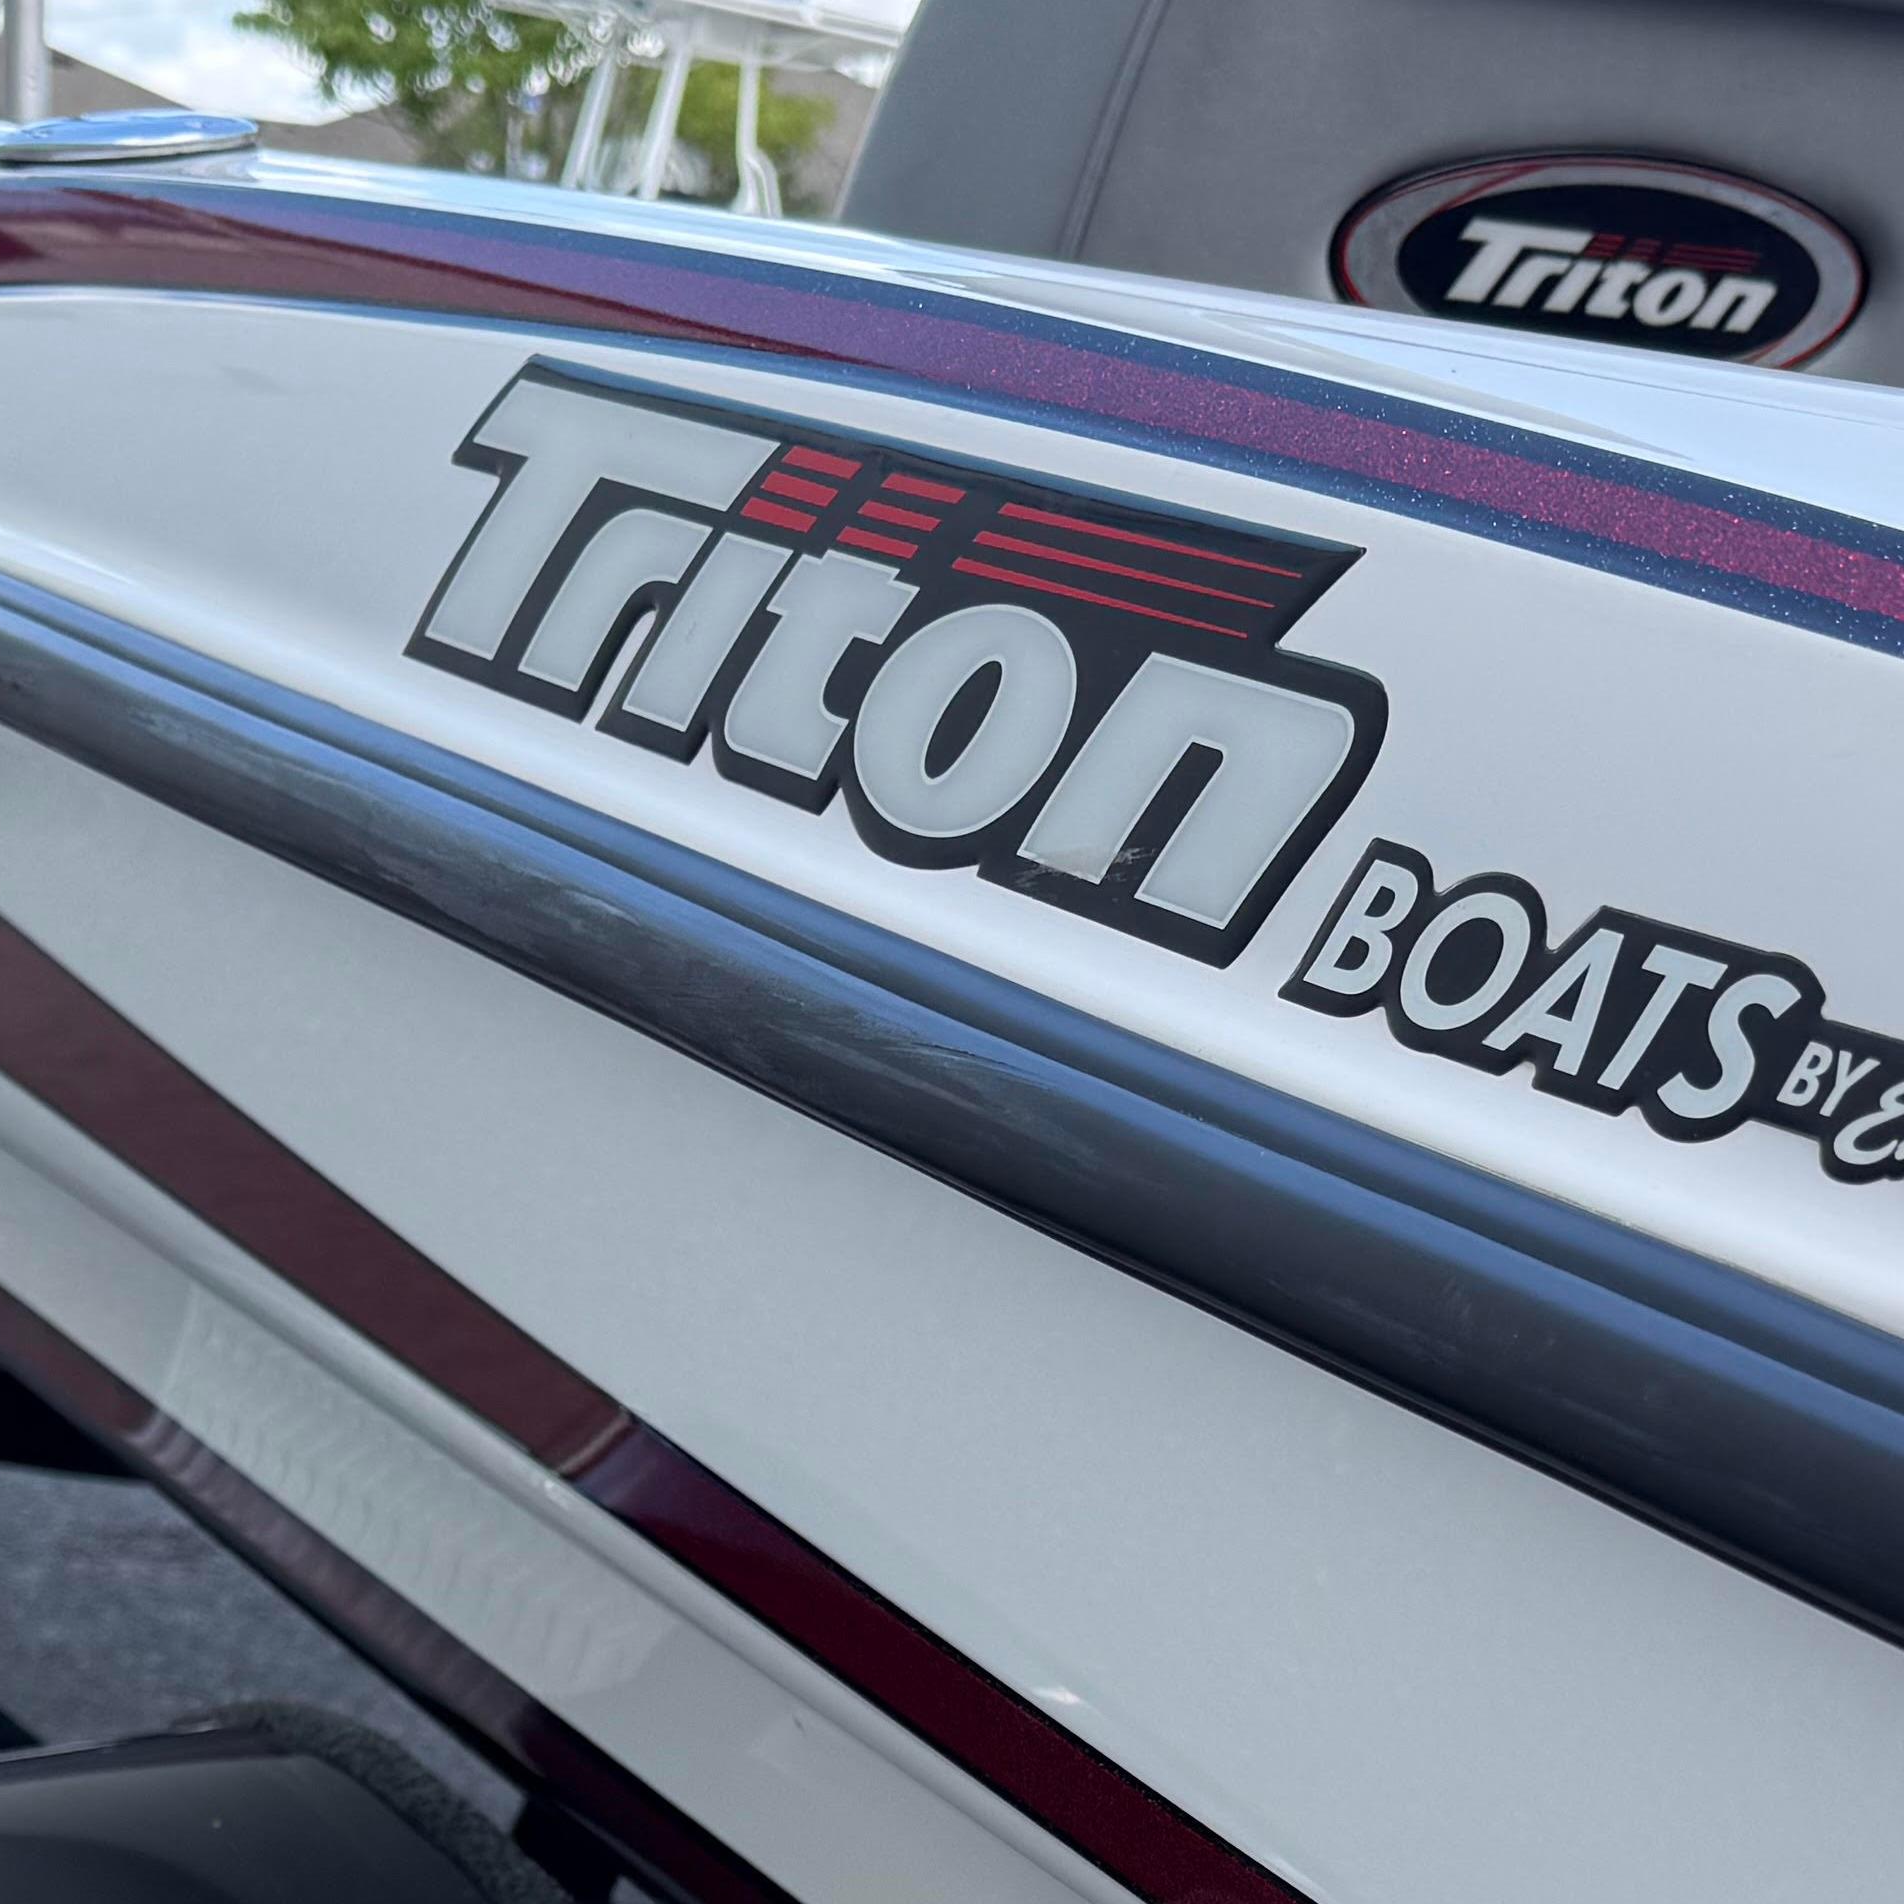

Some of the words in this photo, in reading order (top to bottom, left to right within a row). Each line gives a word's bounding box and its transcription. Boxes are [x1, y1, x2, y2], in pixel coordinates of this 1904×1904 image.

[1445, 217, 1778, 332] Triton
[424, 378, 1356, 932] Triton
[1303, 858, 1802, 1120] BOATS
[1779, 1041, 1881, 1118] BY
